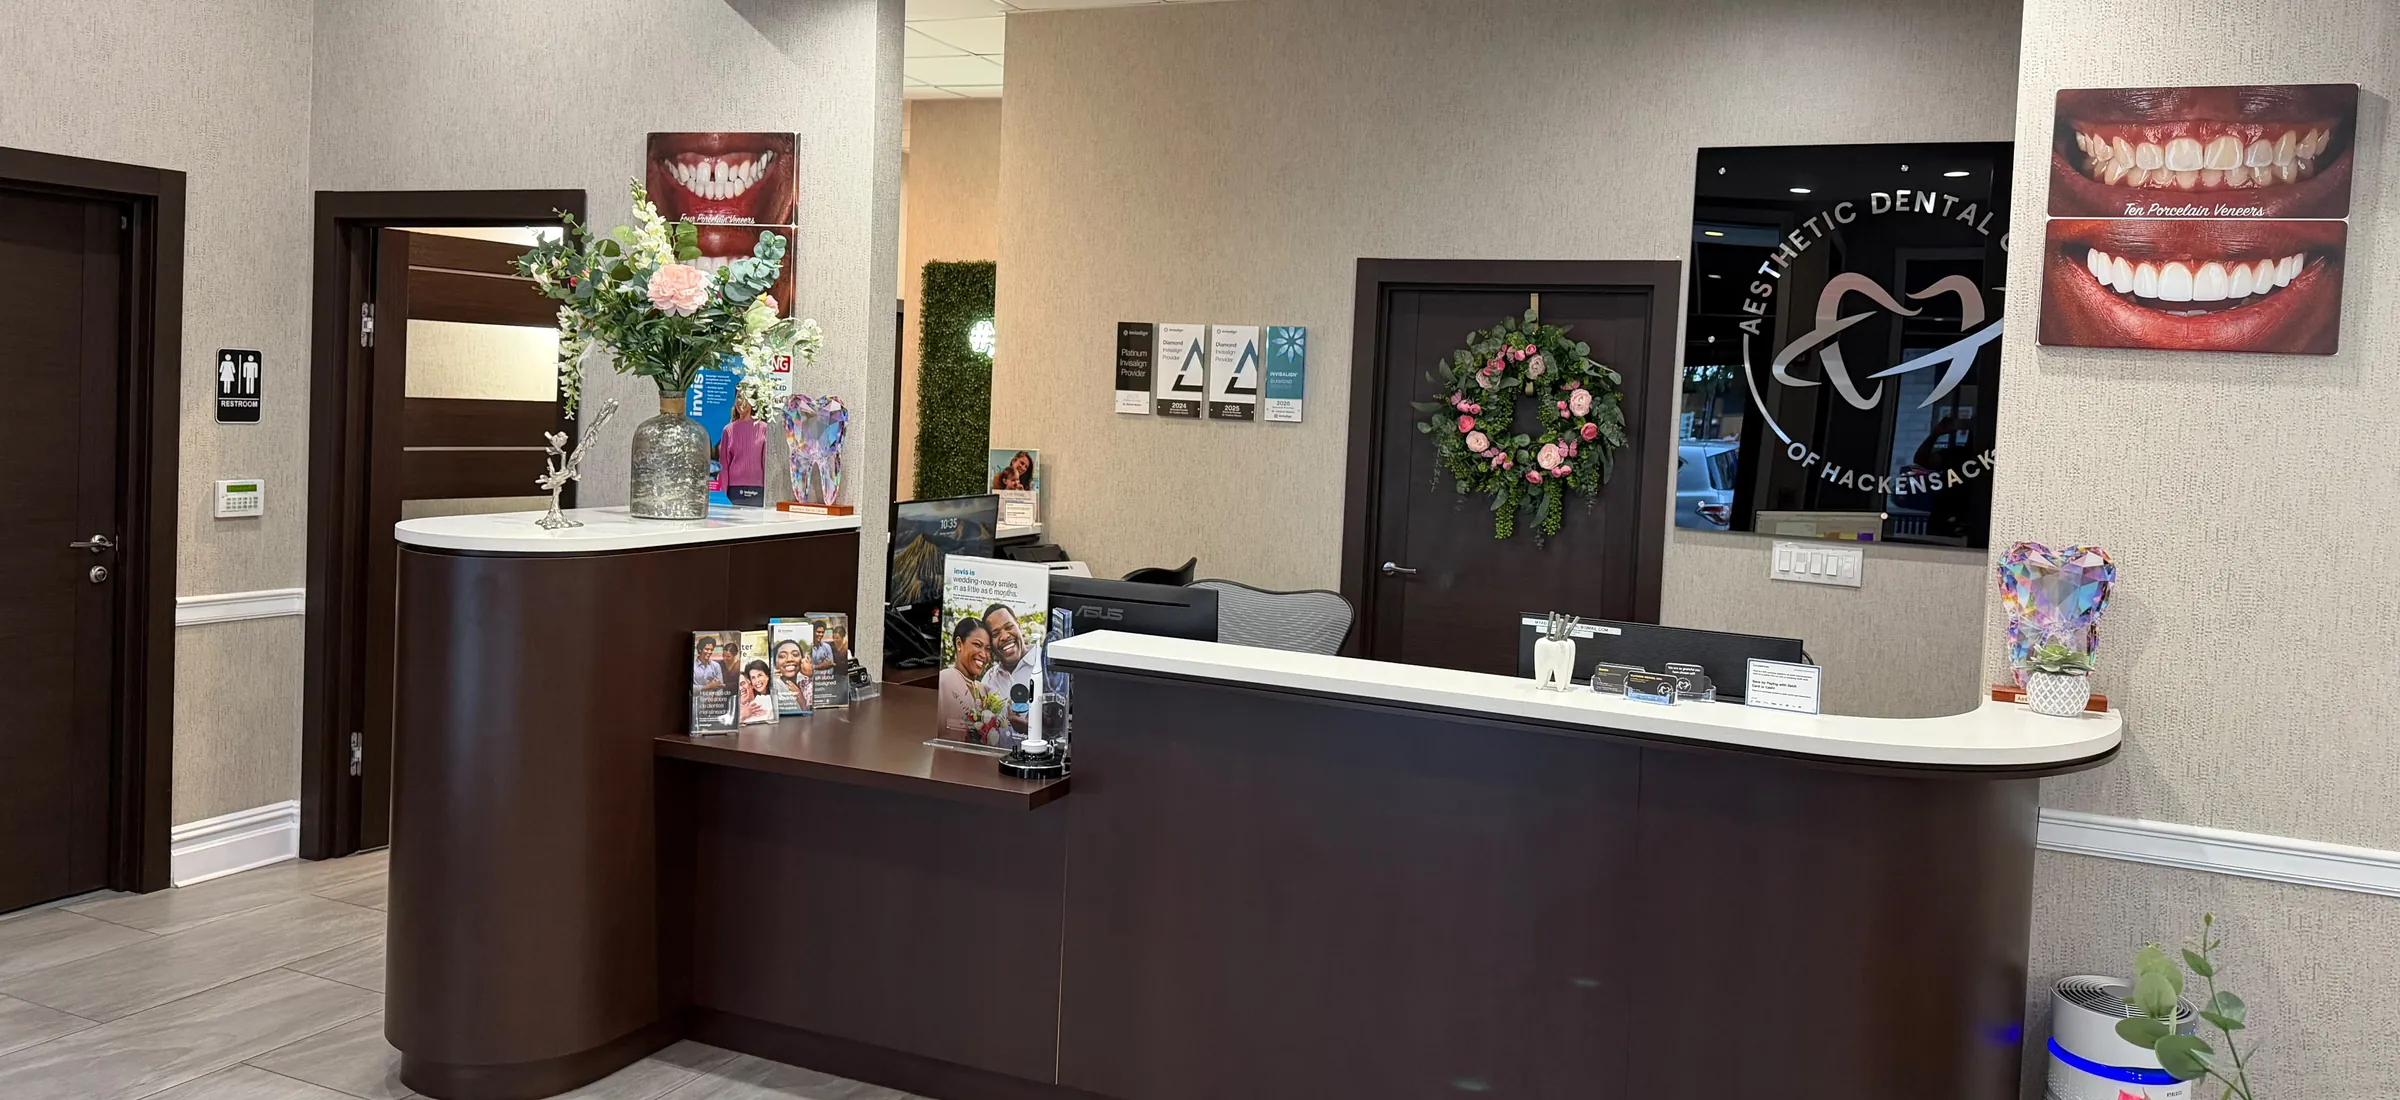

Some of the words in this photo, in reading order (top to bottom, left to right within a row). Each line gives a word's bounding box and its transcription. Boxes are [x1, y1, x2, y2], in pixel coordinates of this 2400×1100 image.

[2123, 203, 2145, 216] Ten
[2147, 203, 2211, 216] Porcelain
[2214, 203, 2265, 216] Veneers
[1739, 201, 1857, 335] AESTHETIC
[1870, 189, 1994, 236] DENTAL
[1121, 348, 1148, 357] Platinum
[1119, 358, 1147, 369] Invisalign
[1120, 368, 1146, 377] Provider
[221, 400, 258, 408] RESTROOM
[1224, 404, 1240, 412] 2025
[1787, 442, 1820, 468] OF
[1820, 448, 1997, 496] HACKENSACK
[941, 517, 957, 529] 10:35
[953, 568, 969, 576] invis
[953, 577, 998, 588] wedding-ready
[998, 581, 1018, 589] smiles
[967, 585, 980, 593] little
[1075, 605, 1123, 621] ASUS
